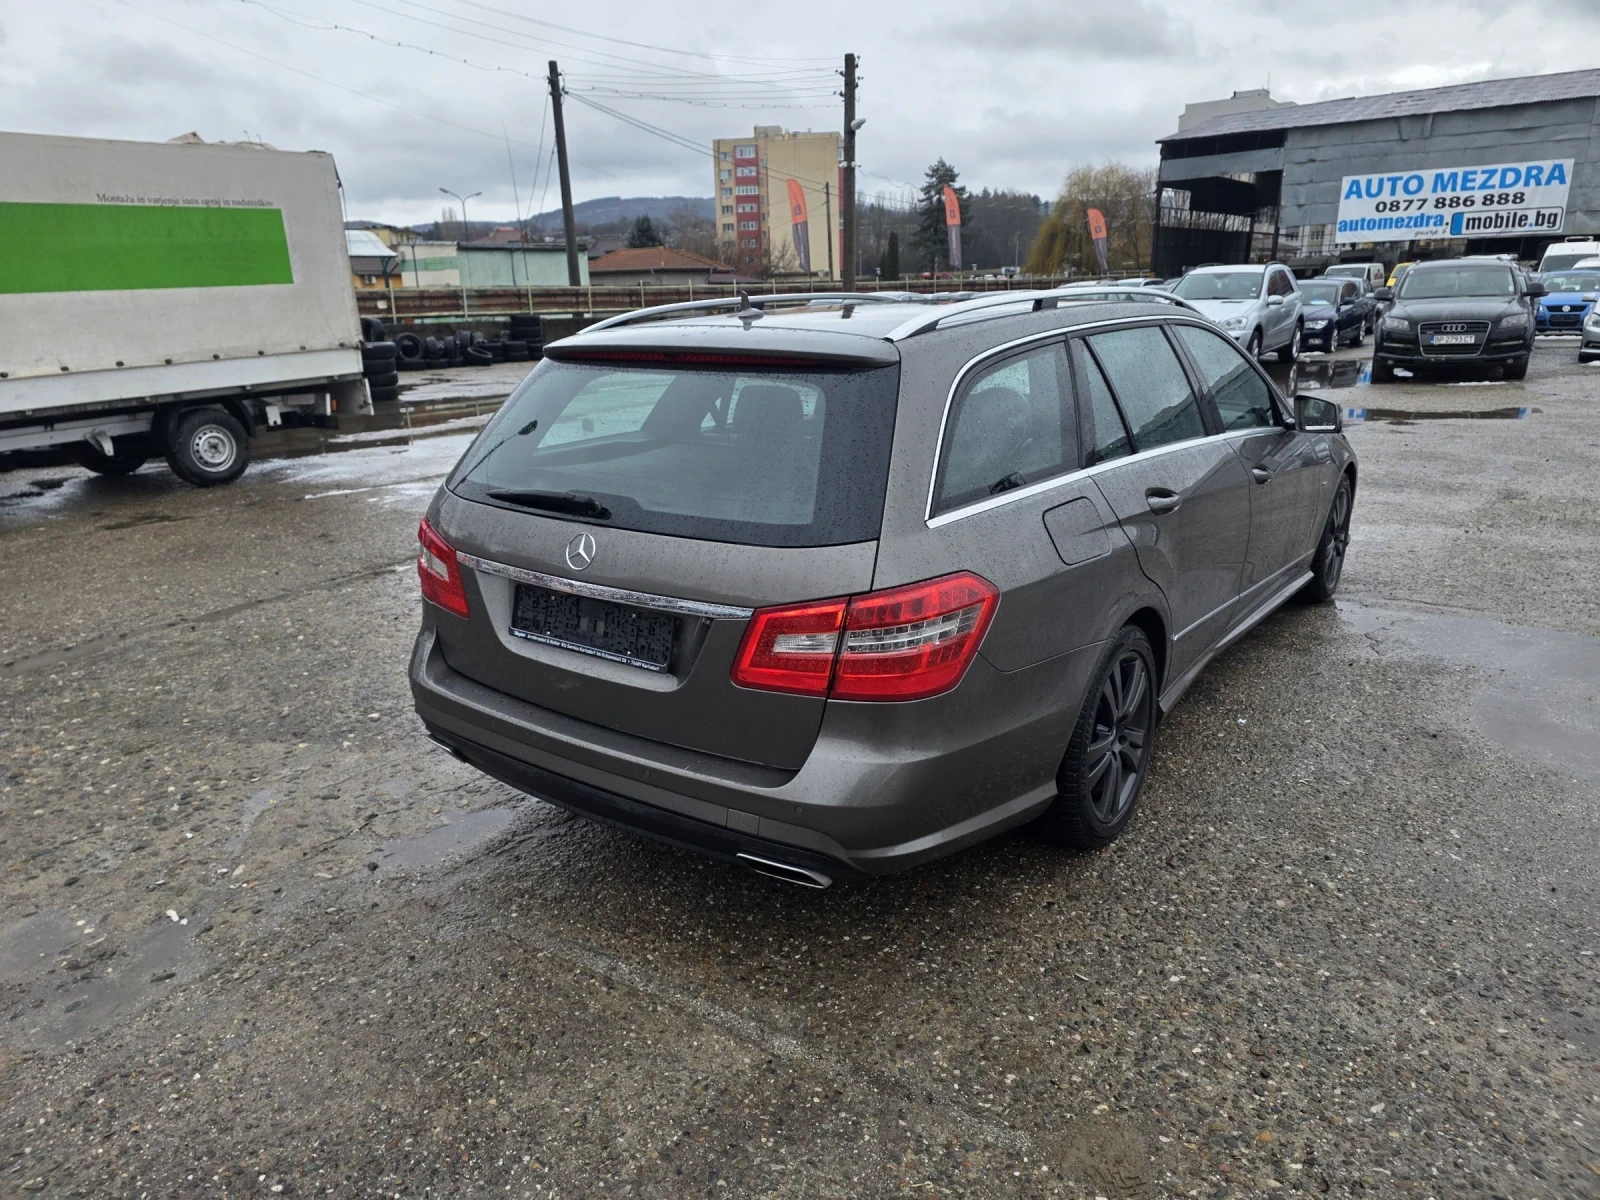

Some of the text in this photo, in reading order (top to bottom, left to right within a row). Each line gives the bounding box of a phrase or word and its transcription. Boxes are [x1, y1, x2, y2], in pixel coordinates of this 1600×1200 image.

[1344, 163, 1567, 200] AUTO MEZDRA
[136, 194, 146, 204] in
[1375, 191, 1526, 213] 0877 886 888
[1465, 210, 1558, 231] mobile.bg
